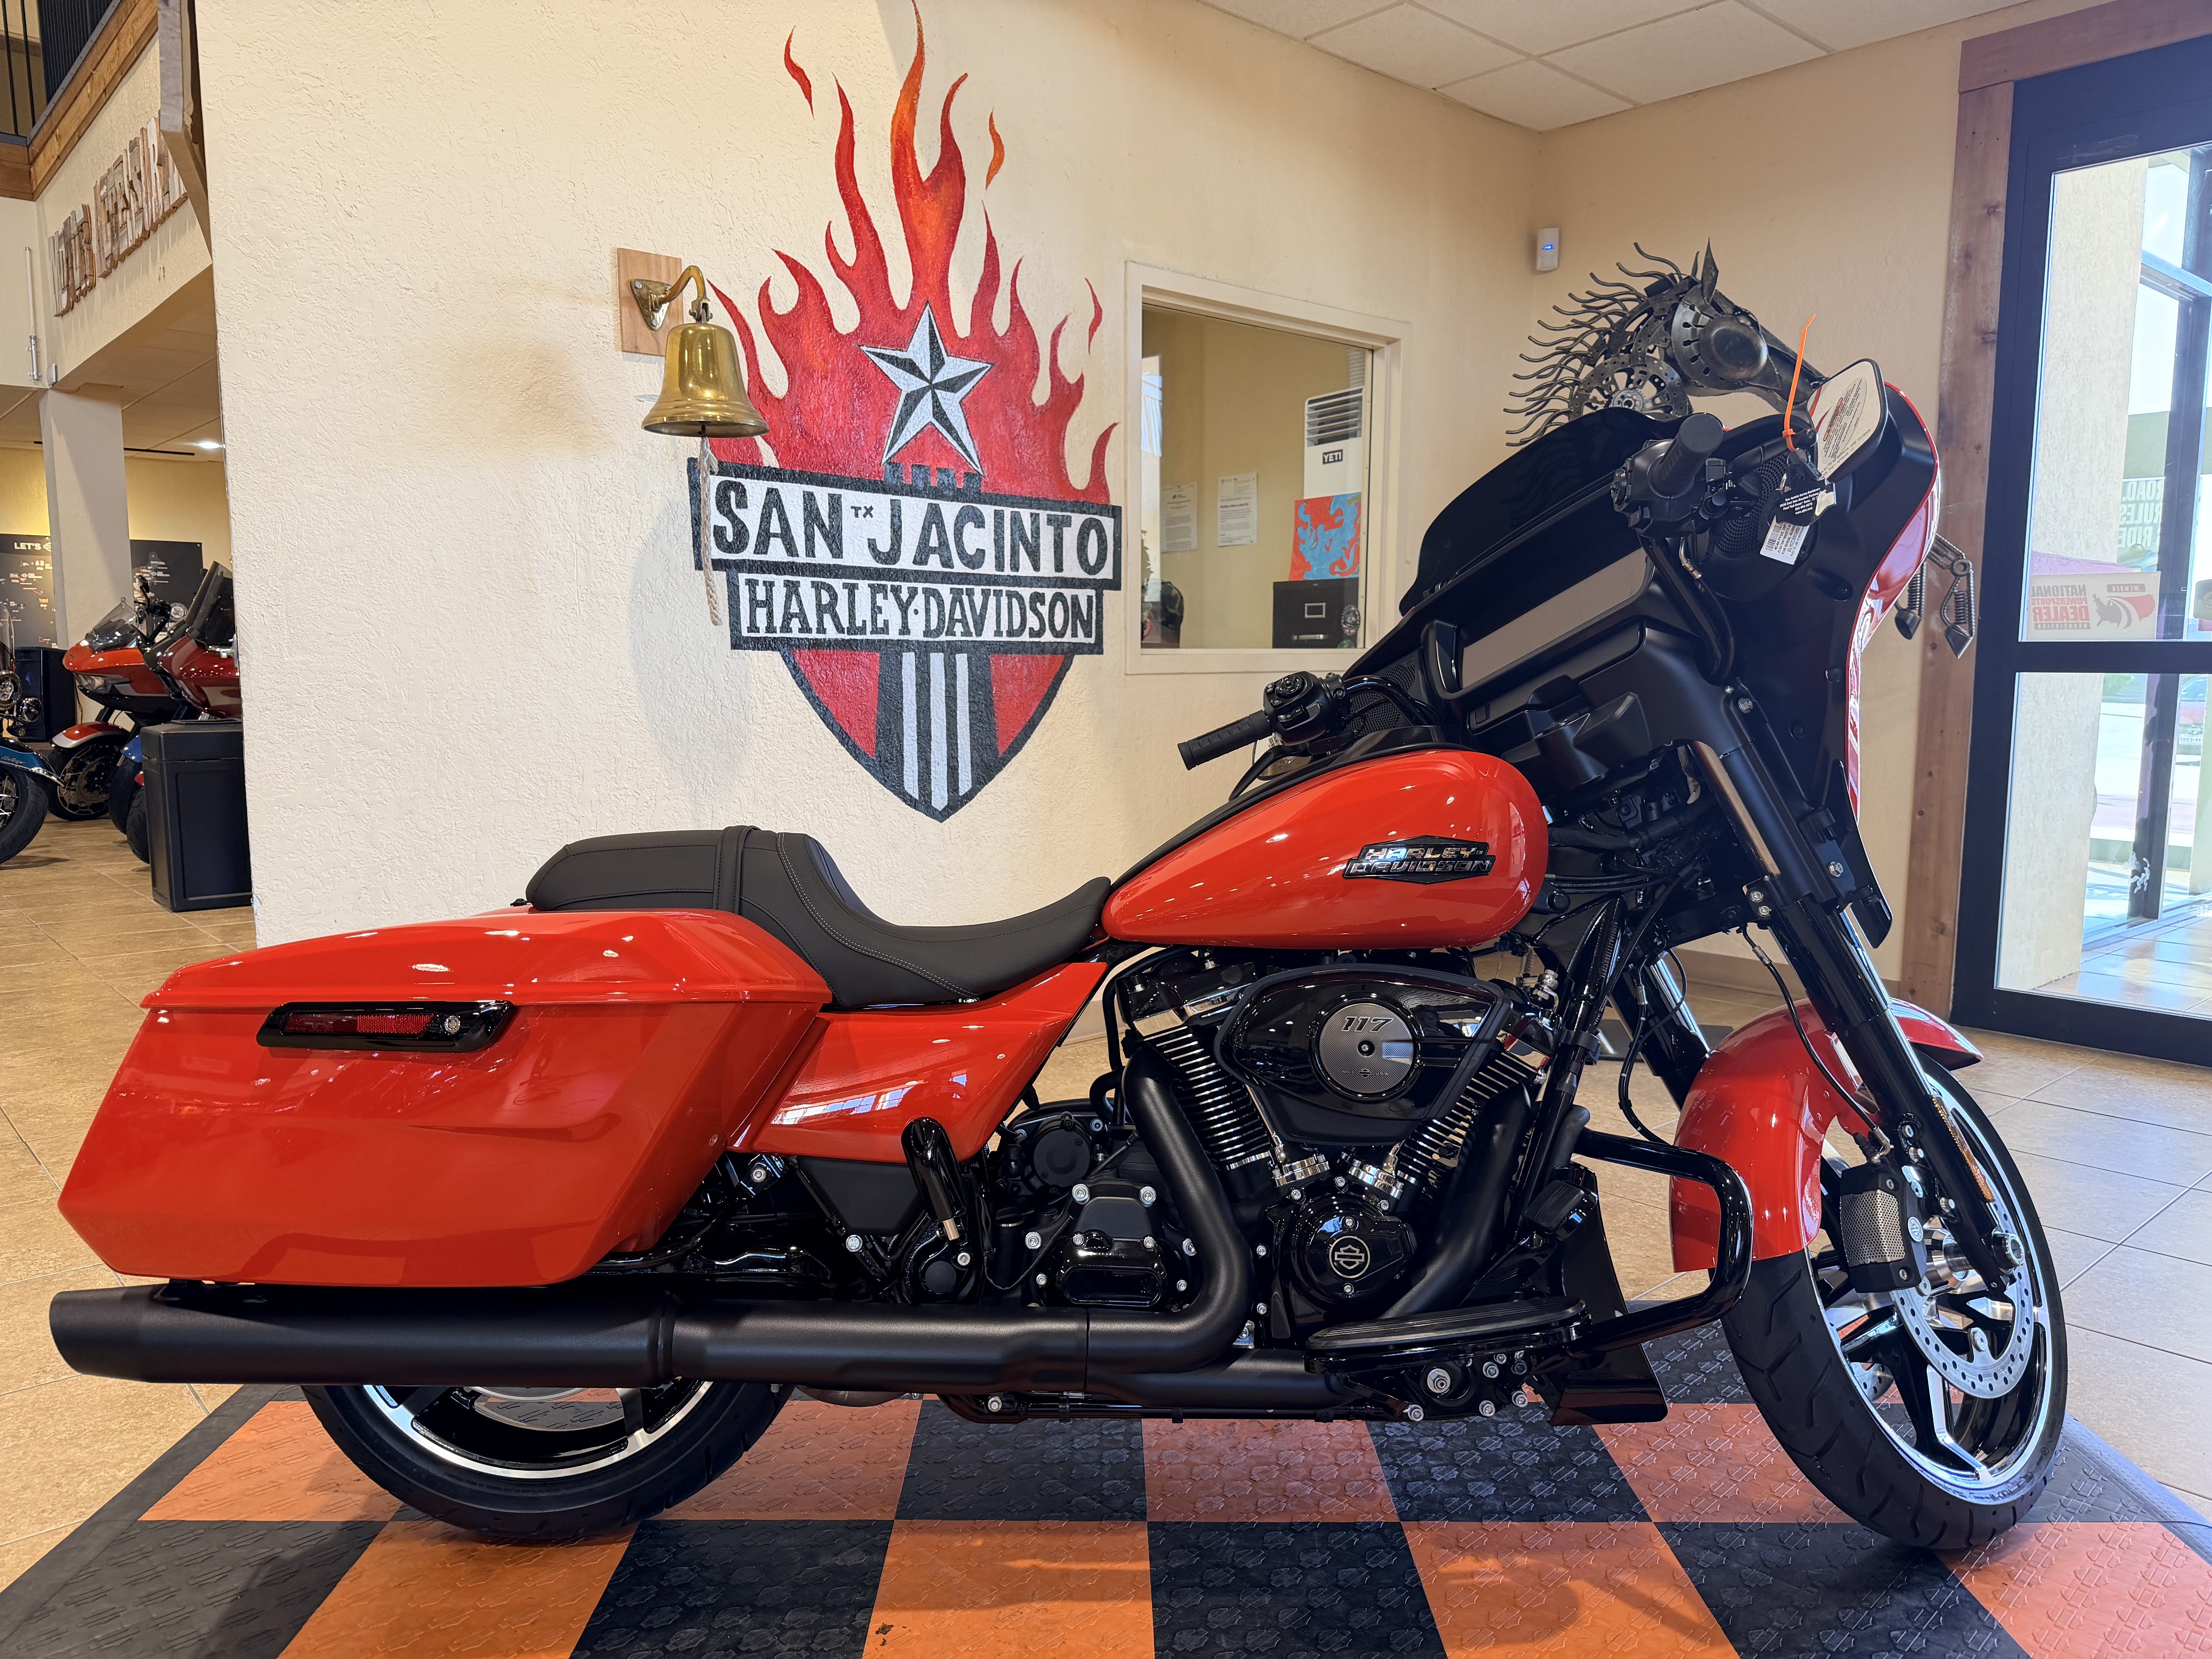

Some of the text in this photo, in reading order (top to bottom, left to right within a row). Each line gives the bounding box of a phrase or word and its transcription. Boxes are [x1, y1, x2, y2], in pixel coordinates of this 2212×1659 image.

[1324, 452, 1341, 462] YETI
[713, 479, 843, 559] SAN
[850, 505, 874, 518] TX
[867, 499, 1108, 575] JACINTO
[1350, 860, 1491, 873] DAVIDSON
[1341, 1016, 1394, 1033] 117
